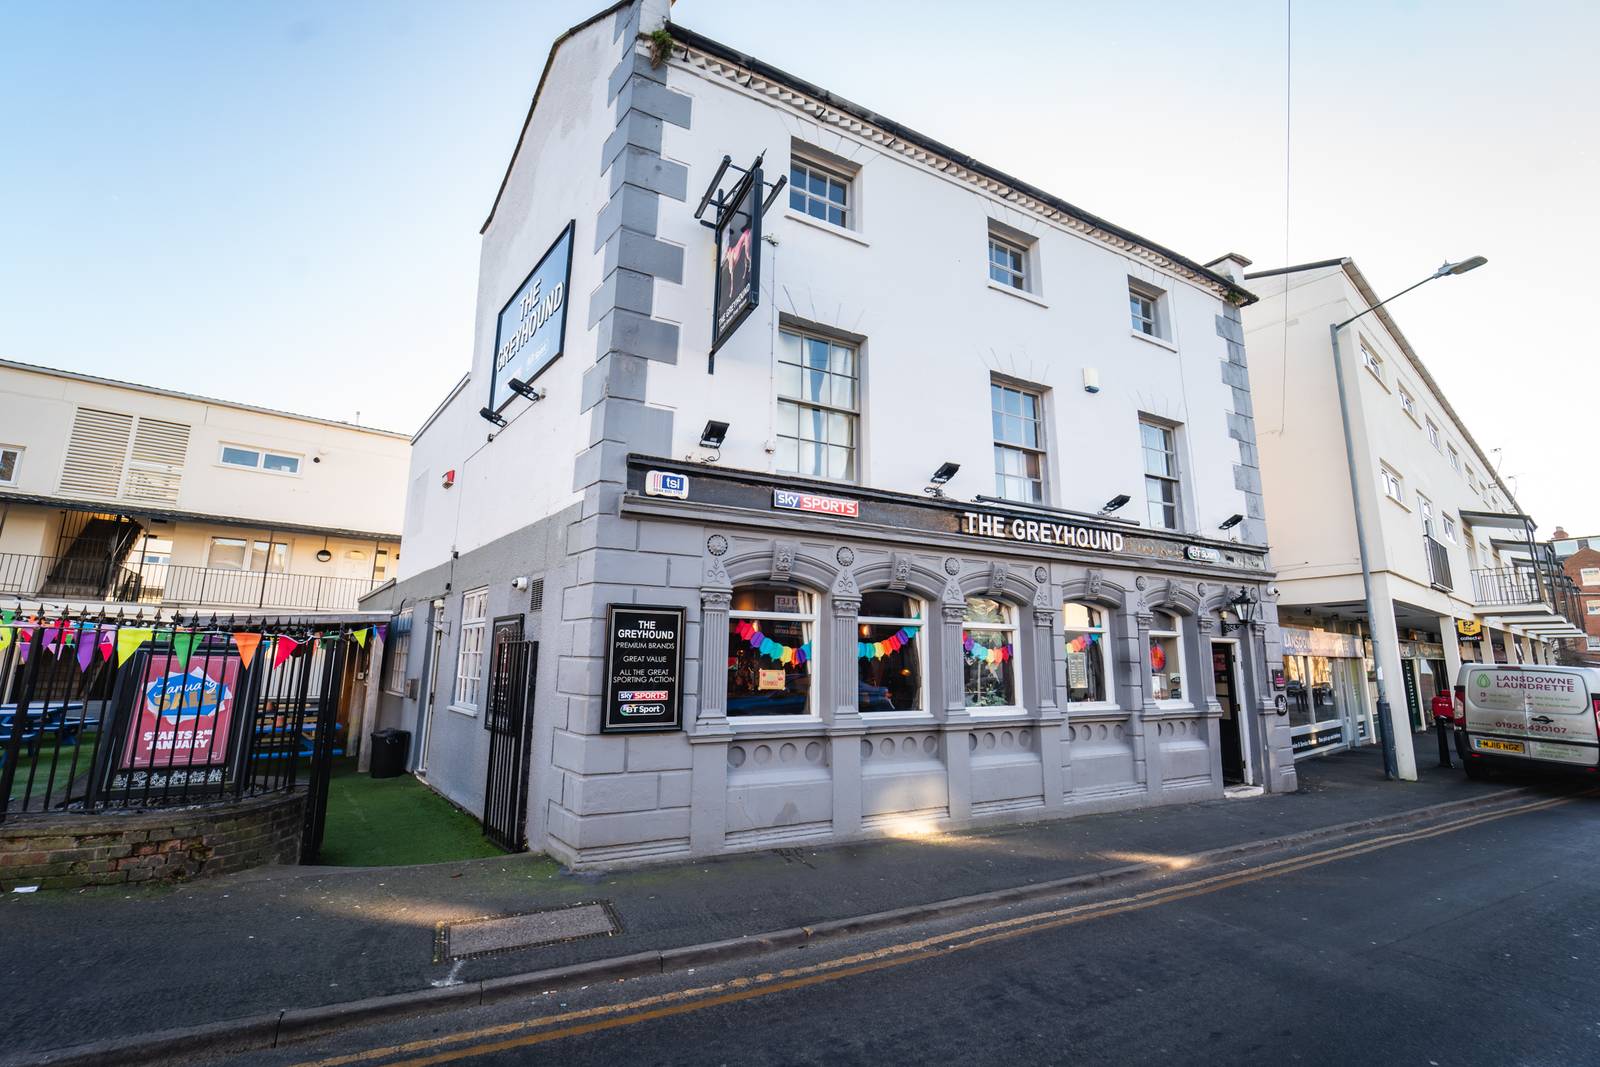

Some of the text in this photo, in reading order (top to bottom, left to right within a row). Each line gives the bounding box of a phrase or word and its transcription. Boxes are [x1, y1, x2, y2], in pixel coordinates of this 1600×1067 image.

[520, 278, 542, 321] THE
[497, 281, 565, 372] GREYHOUND
[666, 477, 680, 489] tsi
[778, 493, 856, 514] sky SPORTS
[964, 512, 1005, 538] THE
[1012, 519, 1124, 551] GREYHOUND
[638, 620, 656, 630] THE
[618, 629, 674, 640] GREYHOUND
[615, 641, 675, 650] PREMIUM BRANDS
[623, 655, 645, 663] GREAT
[619, 668, 632, 676] ALL
[613, 676, 647, 684] SPORTING
[1496, 675, 1575, 685] LANSDOWNE
[1496, 682, 1575, 693] LAUNDRETTE
[620, 691, 666, 700] sky SPORTS
[626, 705, 660, 714] BT Sport
[1495, 722, 1525, 730] 01926
[1528, 725, 1568, 734] 420107
